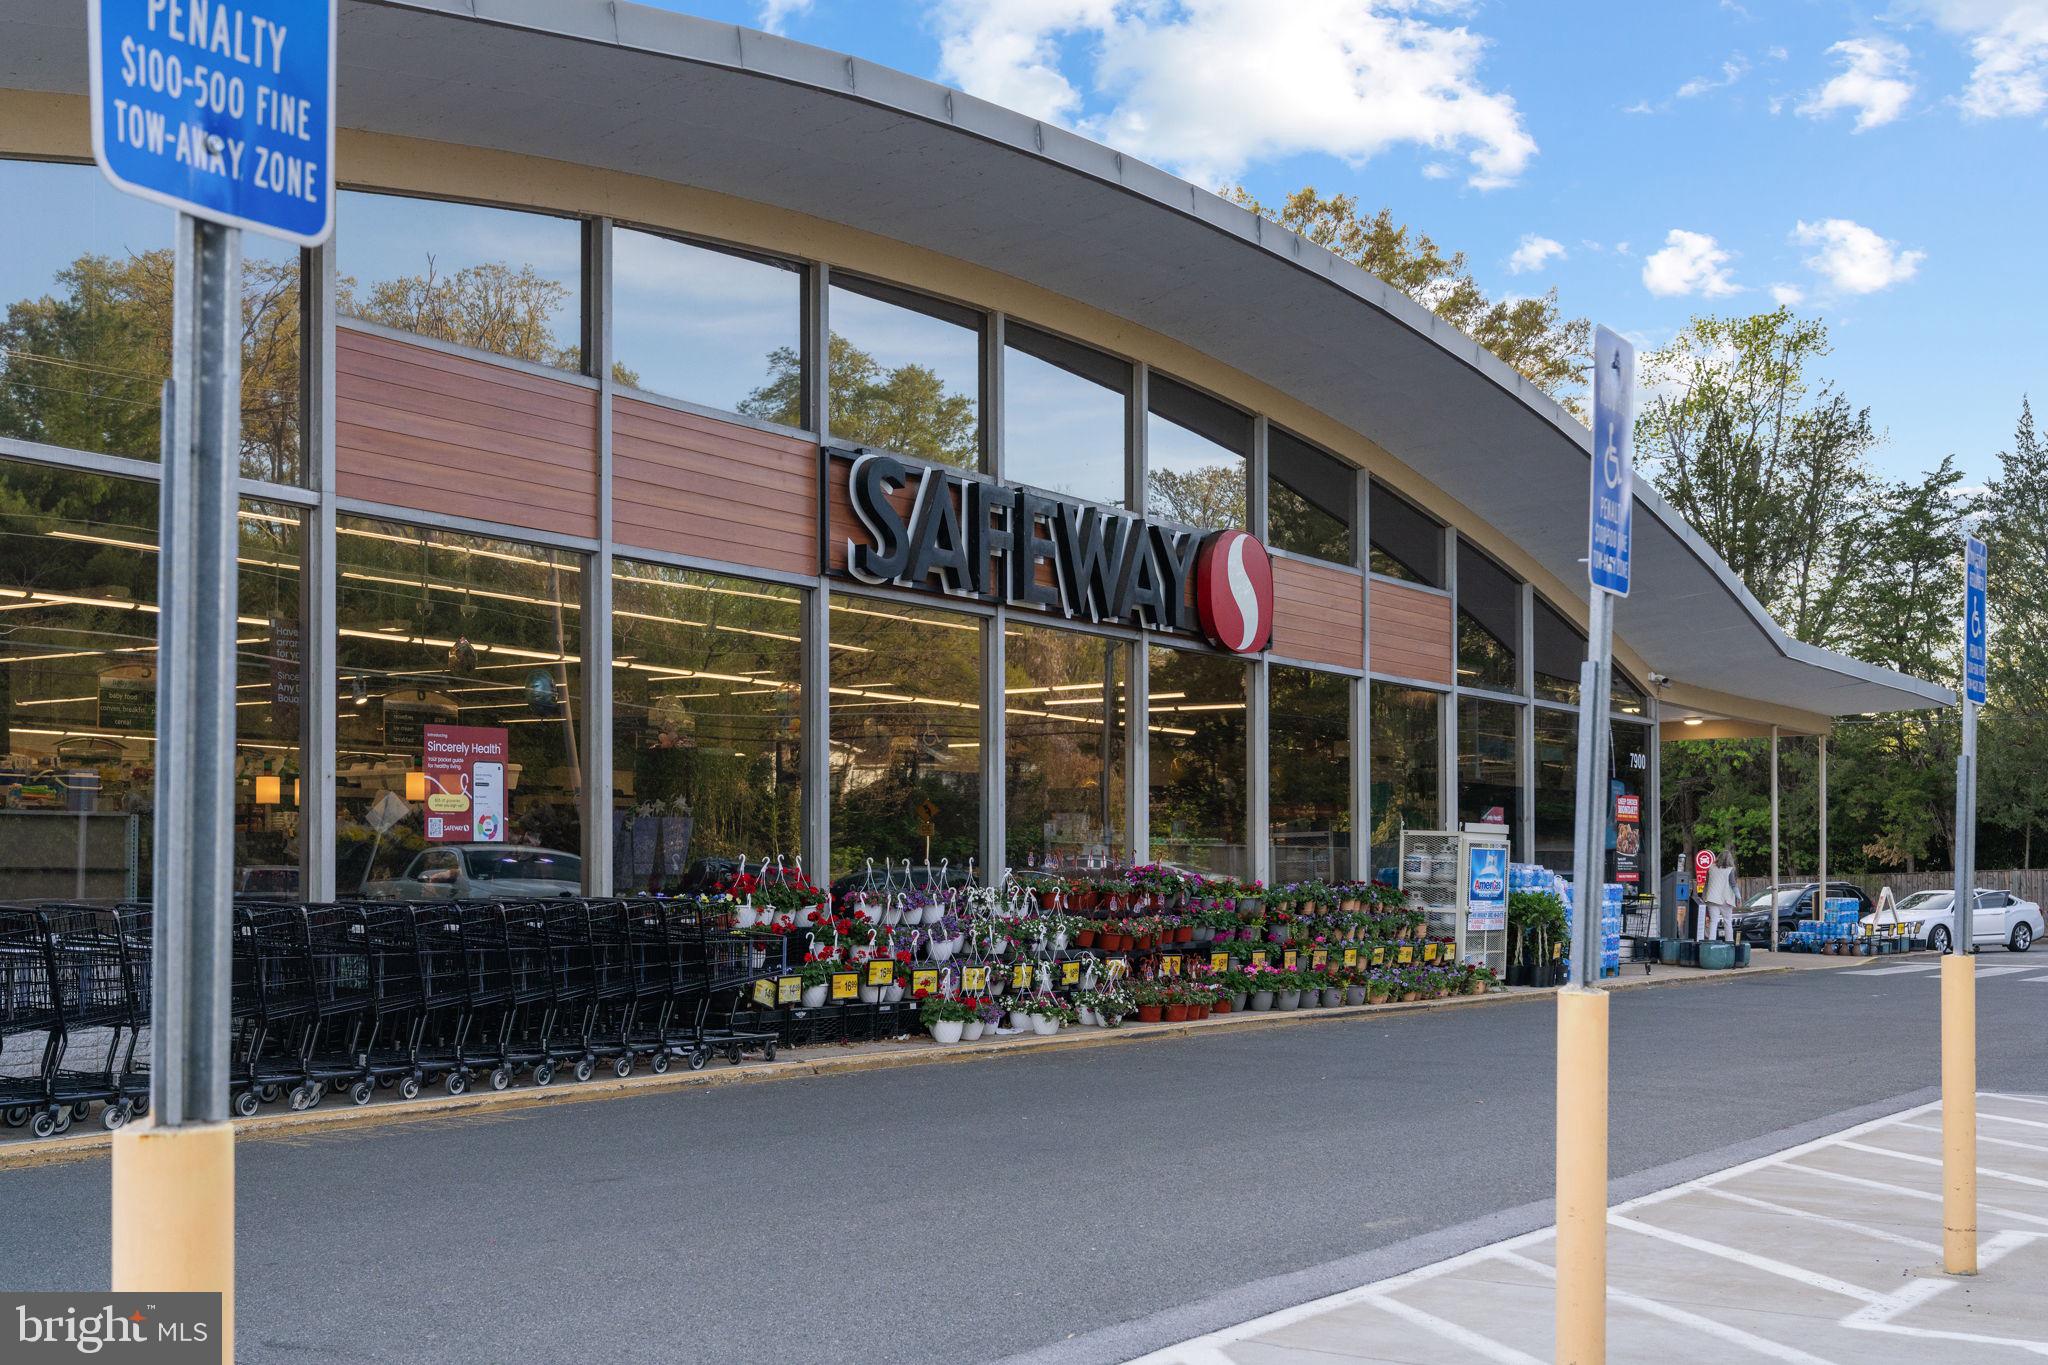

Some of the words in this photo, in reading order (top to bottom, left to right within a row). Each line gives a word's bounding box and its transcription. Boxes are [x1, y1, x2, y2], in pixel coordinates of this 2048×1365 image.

[147, 0, 287, 74] PENALTY
[121, 35, 245, 119] $100-500
[256, 86, 311, 141] FINE
[114, 99, 245, 180] TOW-AWAY
[254, 146, 318, 203] ZONE
[848, 454, 1209, 633] SAFEWAY
[278, 683, 294, 694] Any
[427, 740, 470, 756] Sincerely
[471, 743, 501, 755] Health
[1629, 752, 1646, 770] 7900
